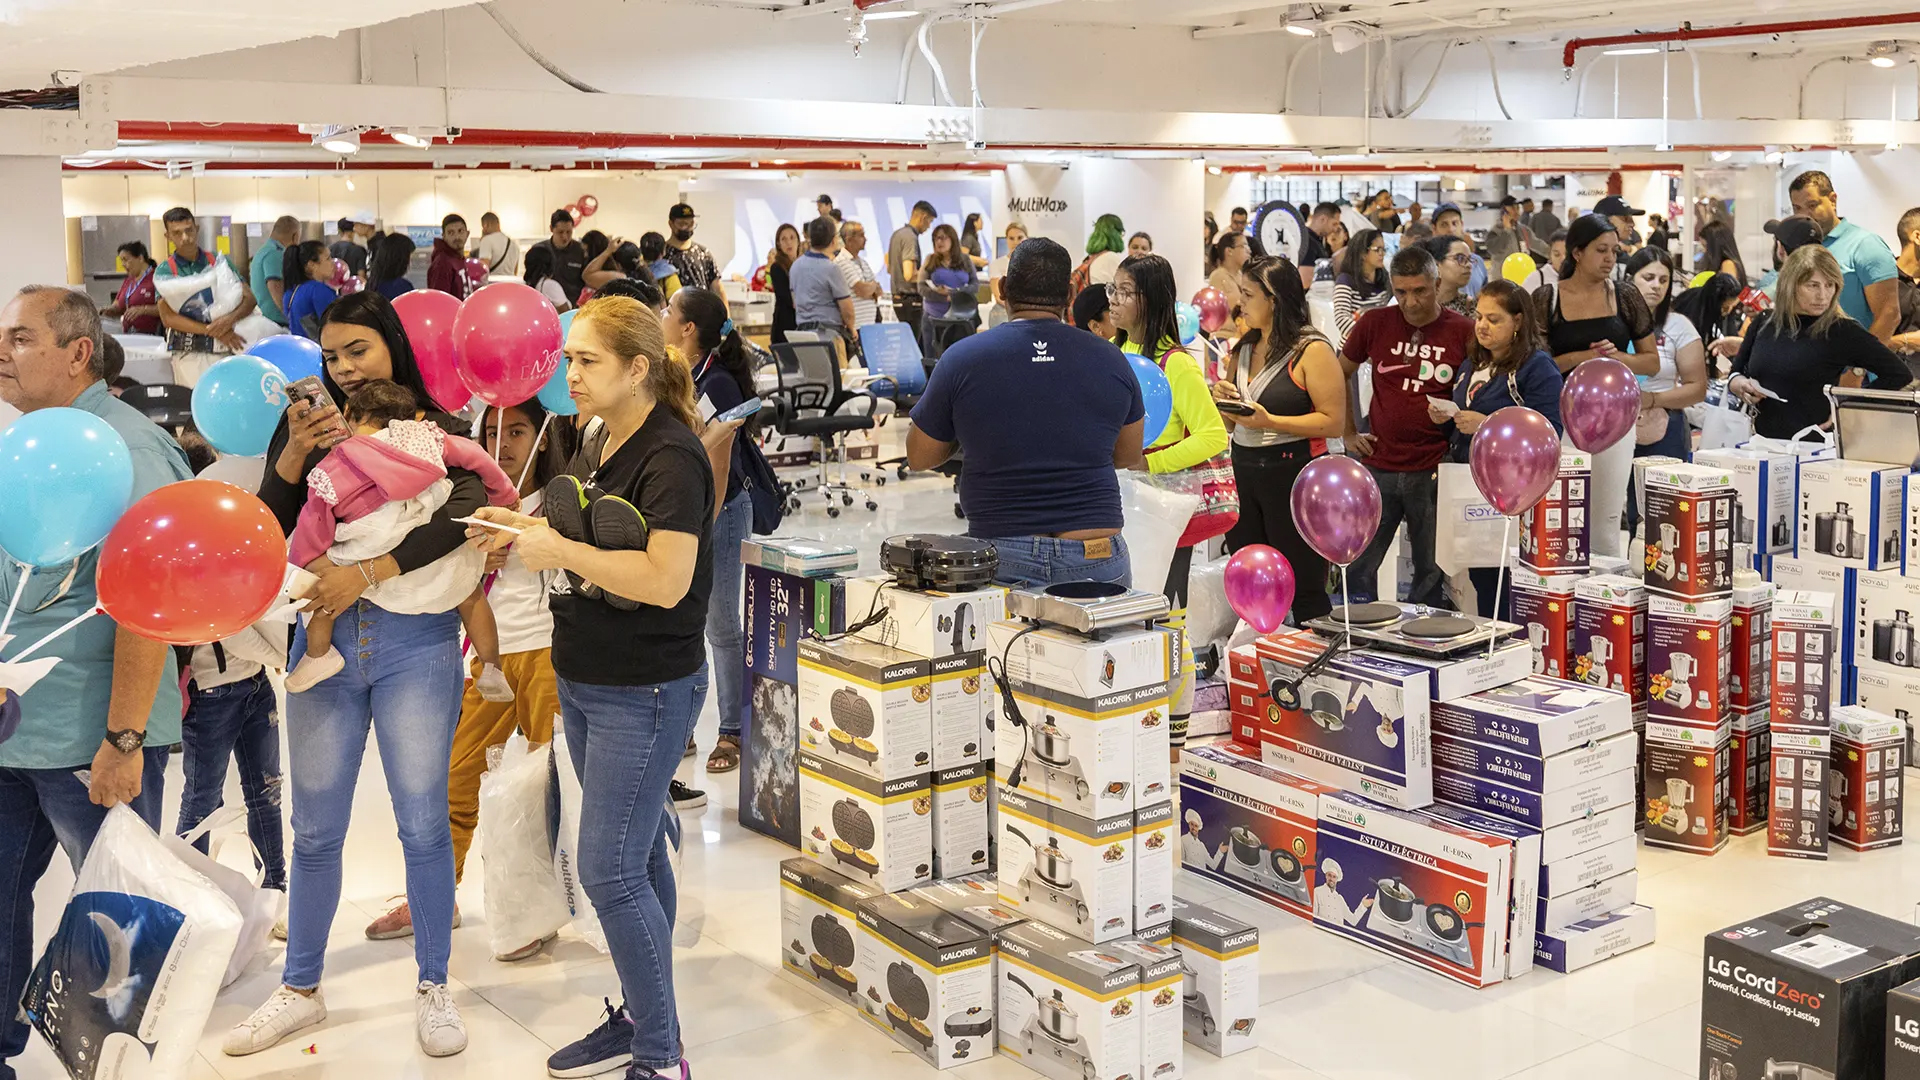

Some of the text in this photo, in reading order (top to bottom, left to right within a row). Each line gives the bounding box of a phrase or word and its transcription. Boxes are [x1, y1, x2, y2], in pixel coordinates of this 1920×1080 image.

[1009, 196, 1062, 212] MultiMax
[1390, 341, 1446, 361] JUST
[1418, 360, 1453, 384] DO
[1402, 378, 1424, 393] IT
[1467, 507, 1502, 517] ROYA
[1775, 565, 1800, 573] ROYAL
[1817, 569, 1840, 578] JUICER
[1861, 578, 1887, 587] ROYAL
[1904, 583, 1920, 591] JUIC
[777, 578, 789, 616] 32"
[770, 598, 776, 616] HD
[747, 578, 755, 653] CYBERLUX
[769, 616, 776, 632] TV
[800, 648, 821, 661] KALORIK
[1172, 632, 1180, 676] KALORIK
[935, 658, 967, 670] KALORIK
[884, 666, 917, 679] KALORIK
[1135, 685, 1167, 699] KALORIK
[1904, 684, 1920, 692] JUIC
[1097, 693, 1132, 707] KALORIK
[1650, 726, 1678, 734] UNIVERSAL
[801, 756, 822, 770] KALORIK
[1184, 758, 1207, 770] UNIVERSAL
[1296, 744, 1364, 772] ESTUFA ELÉCTRICA
[943, 767, 974, 781] KALORIK
[1194, 767, 1206, 776] ROYAL
[885, 779, 918, 793] KALORIK
[1001, 793, 1027, 809] KALORIK
[1212, 787, 1277, 816] ESTUFA ELÉCTRICA
[1139, 806, 1171, 821] KALORIK
[1326, 804, 1353, 816] UNIVERSAL
[1337, 812, 1353, 822] ROYAL
[1097, 818, 1131, 833] KALORIK
[1360, 834, 1438, 867] ESTUFA ELÉCTRICA
[1442, 844, 1473, 860] IU-E02SS
[560, 852, 575, 909] MultiMax
[783, 868, 802, 884] KALORIK
[859, 910, 878, 928] KALORIK
[1190, 917, 1232, 934] KALORIK
[1030, 922, 1070, 941] KALORIK
[1137, 925, 1170, 940] KALORIK
[1224, 931, 1257, 948] KALORIK
[940, 947, 977, 962] KALORIK
[1002, 939, 1029, 957] KALORIK
[1534, 950, 1552, 960] ESTU
[1147, 961, 1181, 977] KALORIK
[1708, 956, 1730, 977] LG
[1104, 970, 1138, 988] KALORIK
[1708, 976, 1820, 1027] Powerful, Cordless, Long-Lasting
[1895, 1015, 1919, 1038] LG
